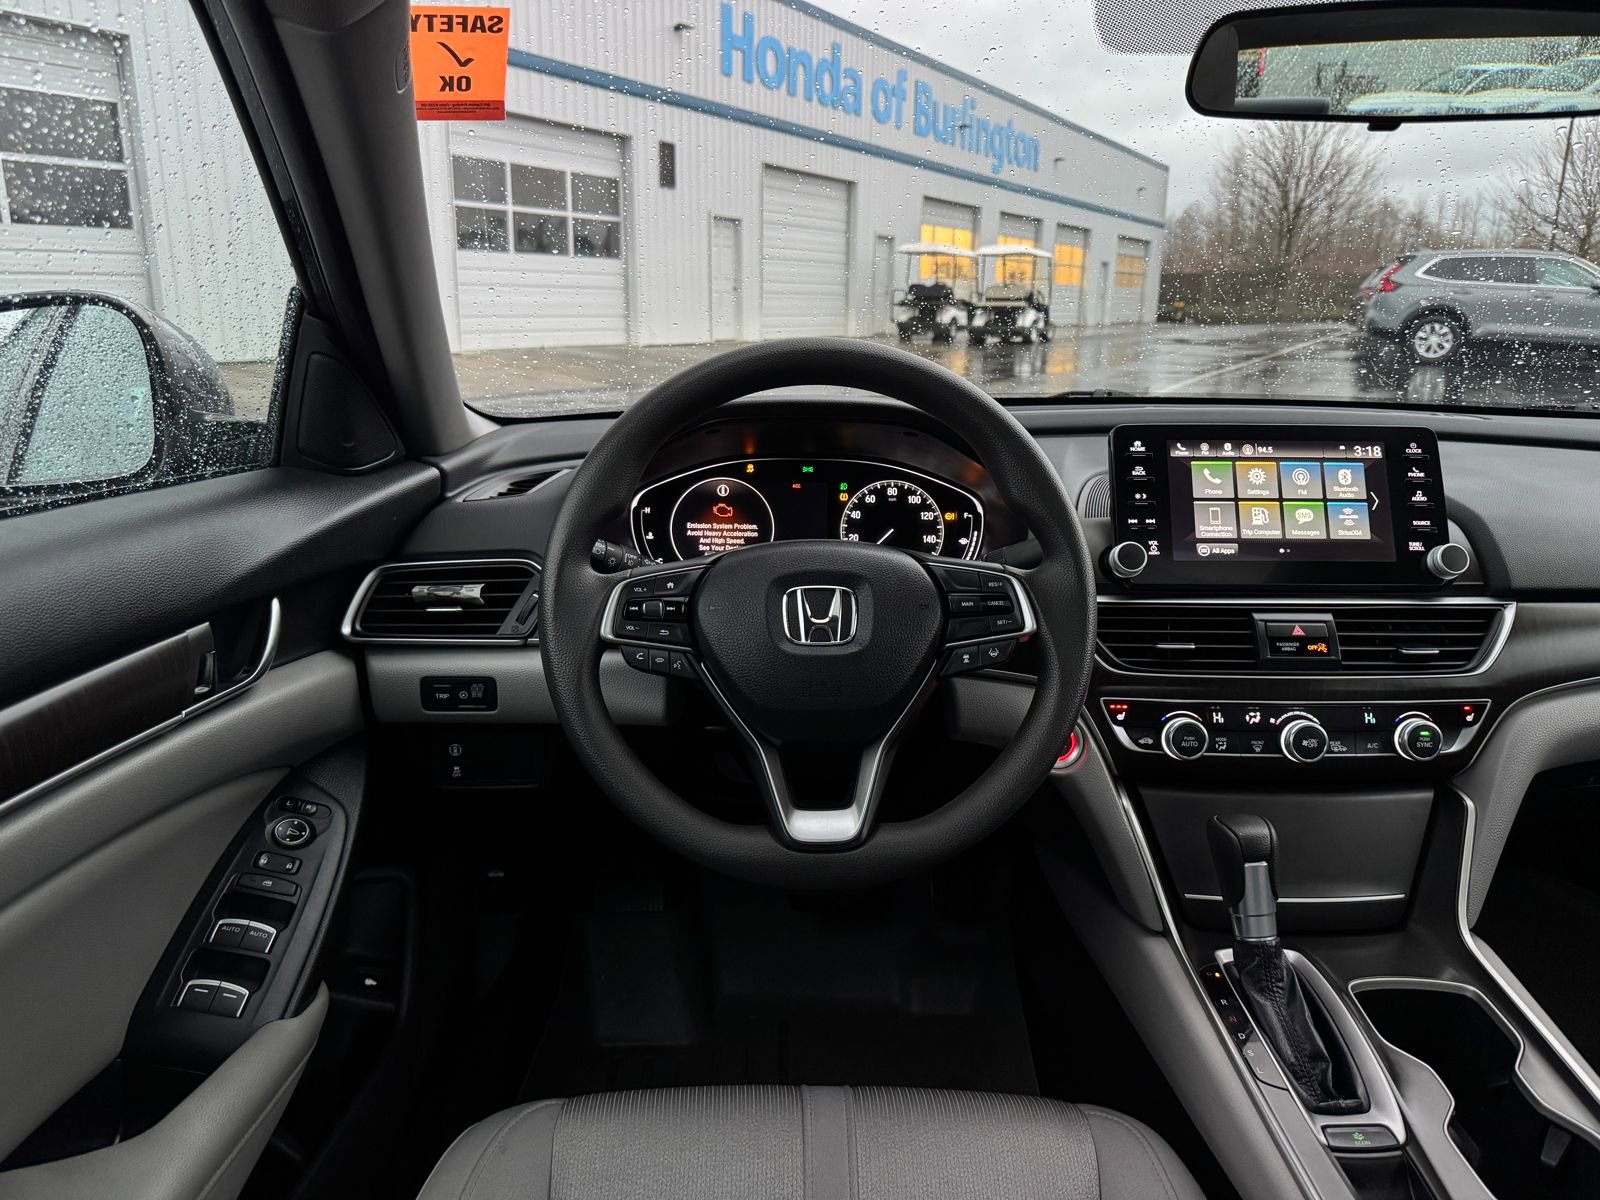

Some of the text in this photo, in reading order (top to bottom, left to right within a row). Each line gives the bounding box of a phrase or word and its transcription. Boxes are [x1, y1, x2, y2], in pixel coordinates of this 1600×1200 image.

[720, 2, 1040, 174] Honda of Burlington
[1257, 446, 1273, 454] 94.5
[1353, 445, 1382, 457] 3:18
[887, 487, 898, 496] 80
[864, 495, 876, 503] 60
[907, 495, 921, 504] 100
[850, 511, 861, 519] 40
[920, 512, 934, 521] 120
[1297, 511, 1312, 519] SMS
[922, 535, 936, 543] 140
[1221, 547, 1235, 555] Apps
[221, 924, 241, 933] AUTO
[249, 930, 268, 939] AUTO
[1237, 1032, 1246, 1040] D
[1247, 1049, 1255, 1057] S
